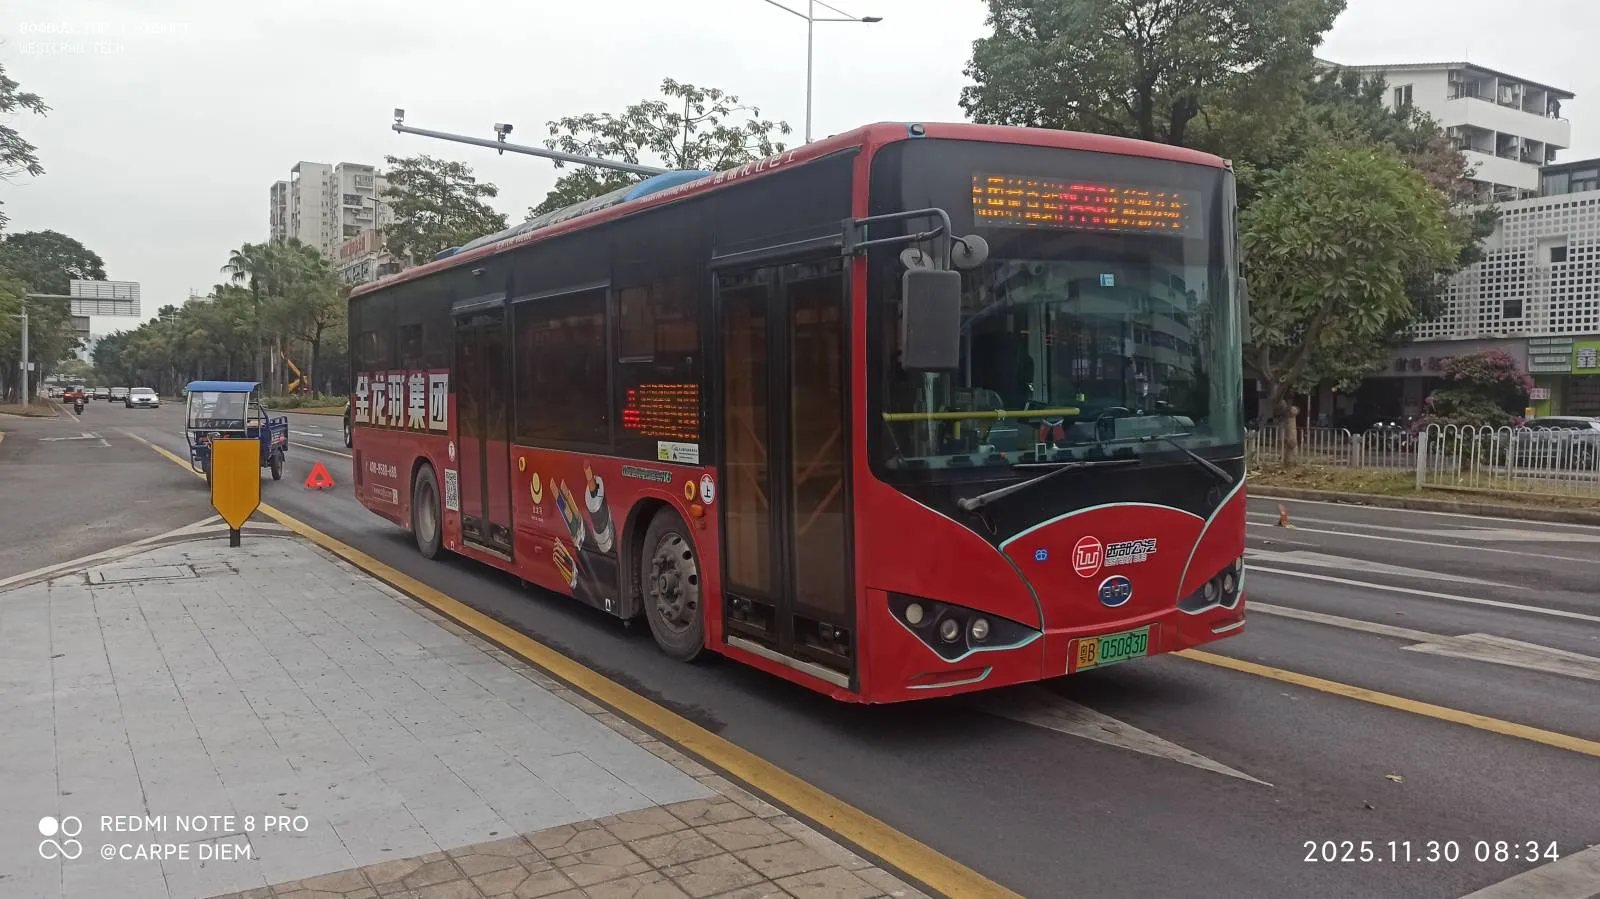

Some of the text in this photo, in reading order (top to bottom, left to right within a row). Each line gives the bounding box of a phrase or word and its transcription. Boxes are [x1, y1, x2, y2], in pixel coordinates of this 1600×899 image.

[355, 373, 449, 431] 金龙羽集团
[704, 485, 712, 499] 上
[1102, 583, 1130, 599] BYD
[1101, 633, 1148, 660] 05083D
